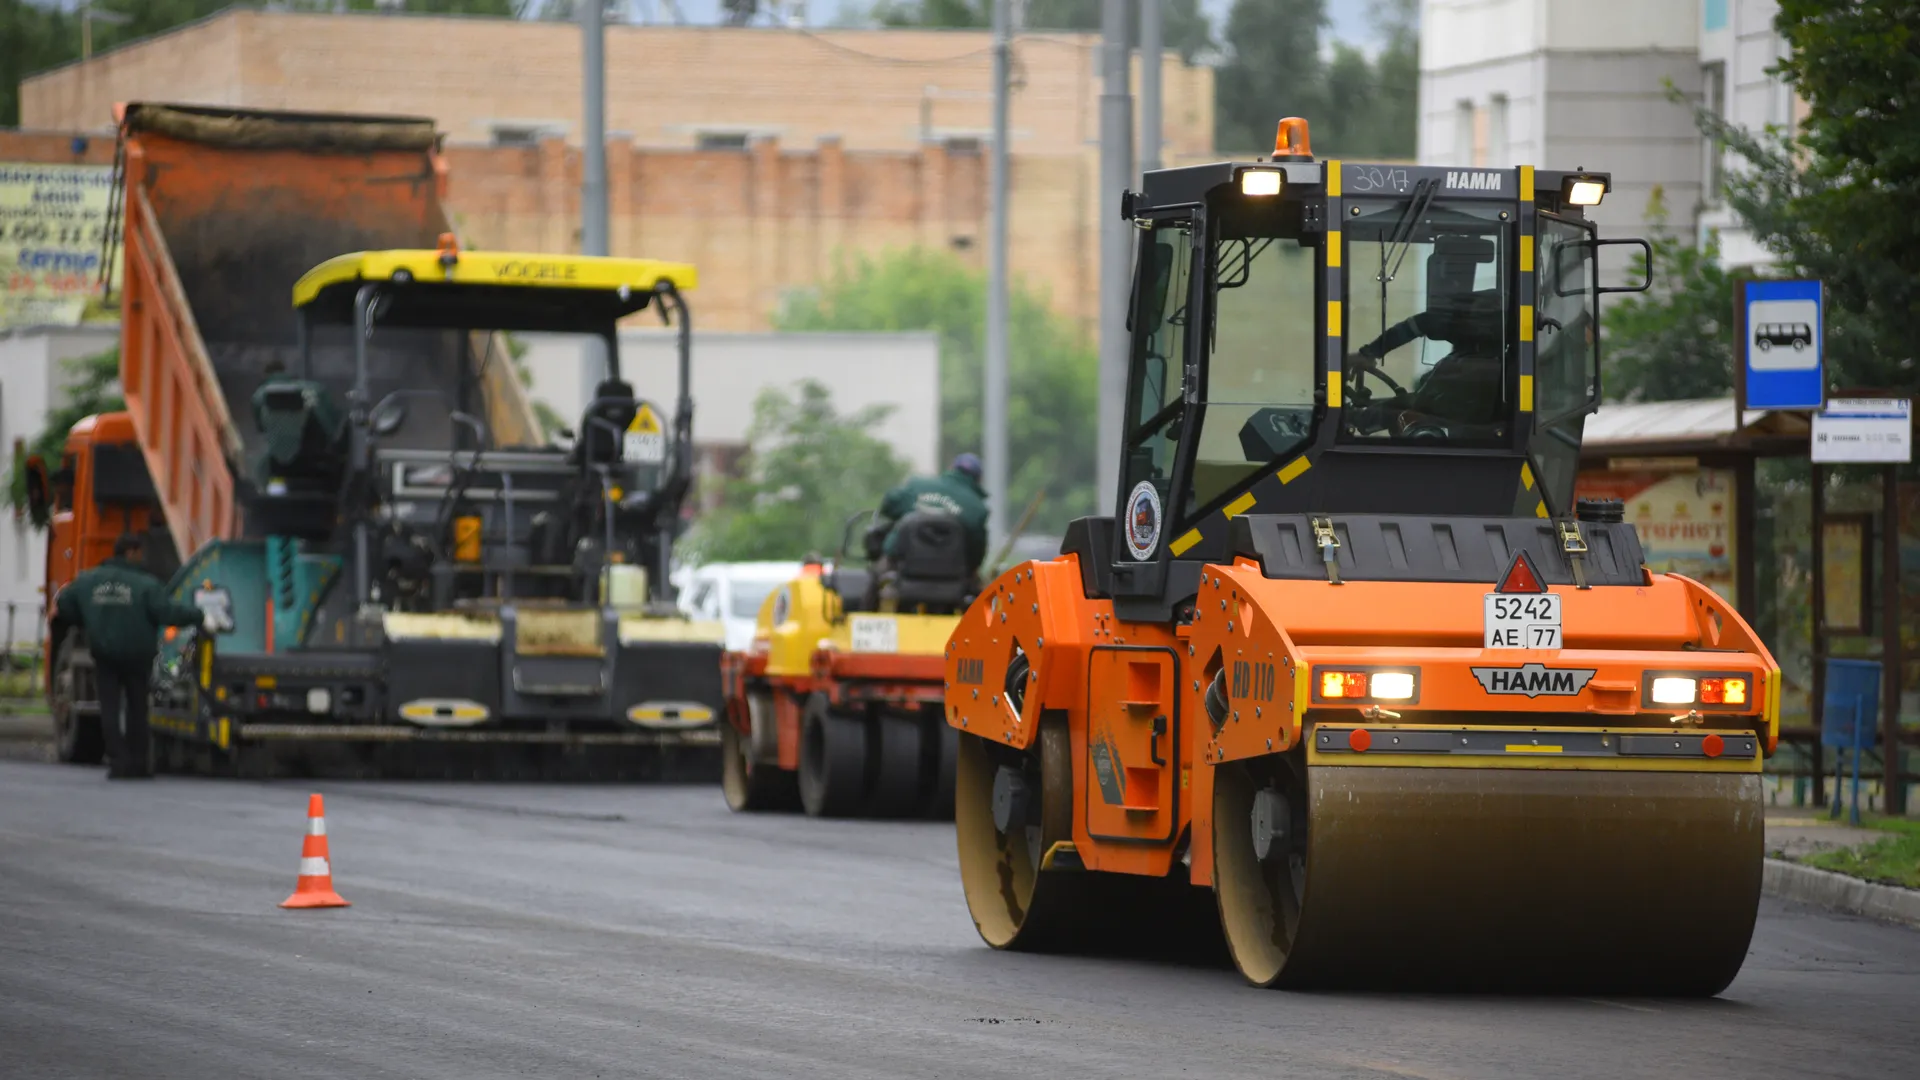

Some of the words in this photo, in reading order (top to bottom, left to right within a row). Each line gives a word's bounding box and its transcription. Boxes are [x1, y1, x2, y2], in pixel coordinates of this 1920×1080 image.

[1353, 166, 1410, 191] 3017
[1446, 171, 1501, 190] HAMM
[1495, 598, 1552, 620] 5242
[1492, 629, 1519, 646] AE
[1533, 629, 1555, 646] 77
[957, 658, 984, 685] HAMM
[1232, 660, 1251, 699] HD
[1254, 661, 1275, 702] 110
[1491, 671, 1574, 692] HAMM
